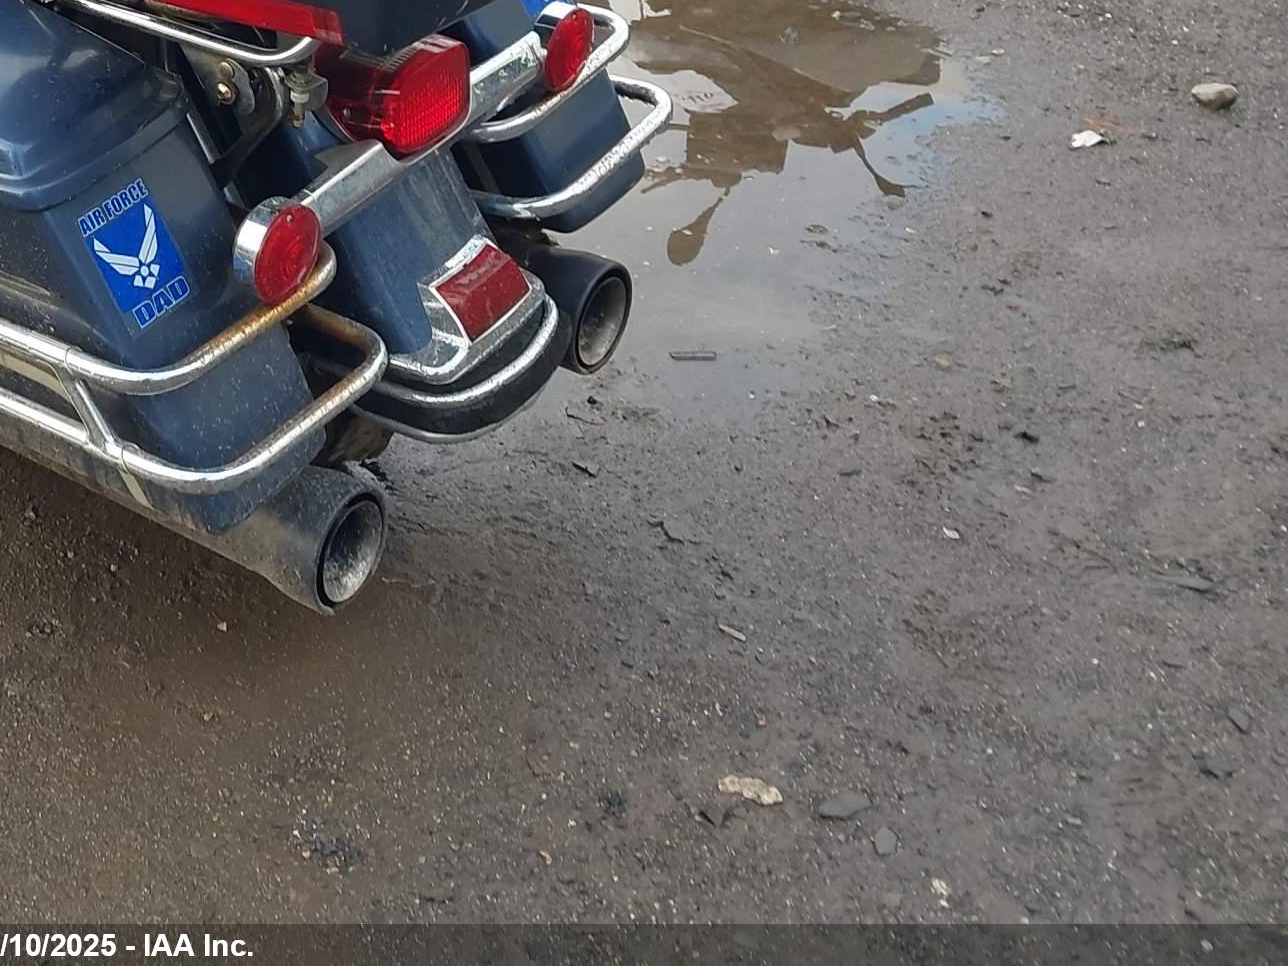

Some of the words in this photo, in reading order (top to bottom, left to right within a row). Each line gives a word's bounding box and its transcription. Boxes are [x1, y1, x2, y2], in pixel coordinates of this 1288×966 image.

[78, 207, 107, 237] AIR
[102, 178, 148, 220] FORCE
[132, 275, 191, 329] DAD
